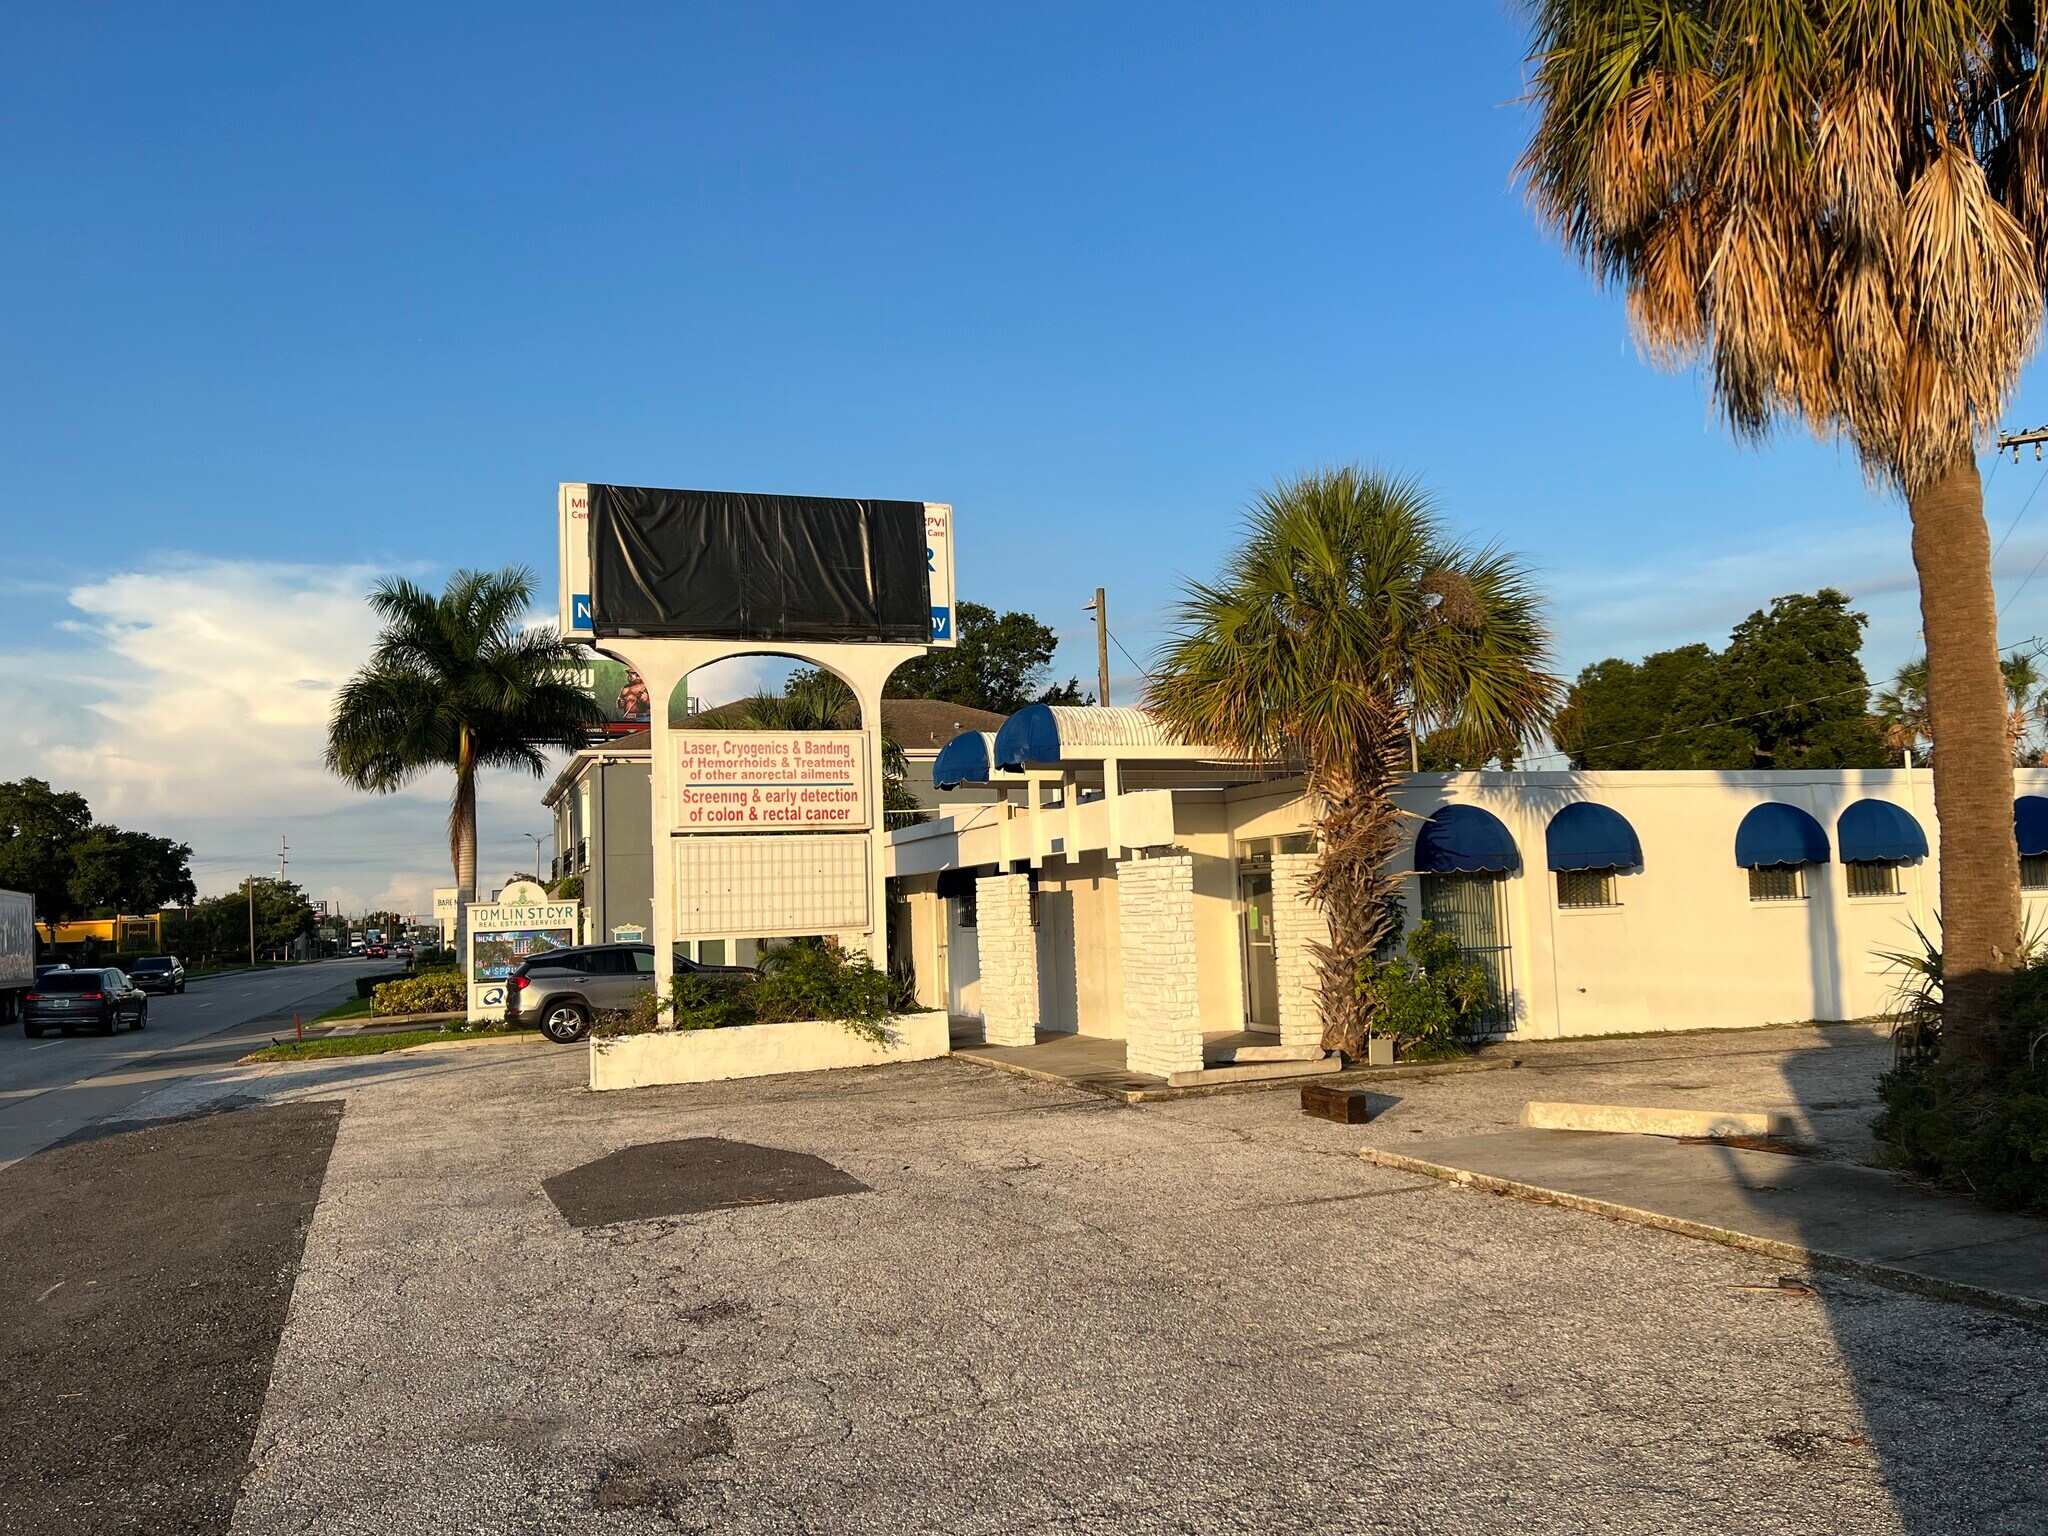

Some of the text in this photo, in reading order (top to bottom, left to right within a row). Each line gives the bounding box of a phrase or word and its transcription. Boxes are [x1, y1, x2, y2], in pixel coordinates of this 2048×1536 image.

[927, 529, 945, 538] Care
[683, 740, 850, 758] Laser, Cryogenics & Banding
[681, 757, 856, 769] of Hemorrhoids & Treatment
[690, 769, 850, 780] of other anorectal ailments
[683, 788, 858, 806] Screening & early detection
[689, 806, 850, 822] of colon & rectal cancer
[472, 908, 523, 922] TOMLIN
[546, 906, 574, 919] CYR
[500, 920, 528, 928] ESTATE
[530, 918, 567, 927] SERVICES
[493, 966, 517, 976] SPRI
